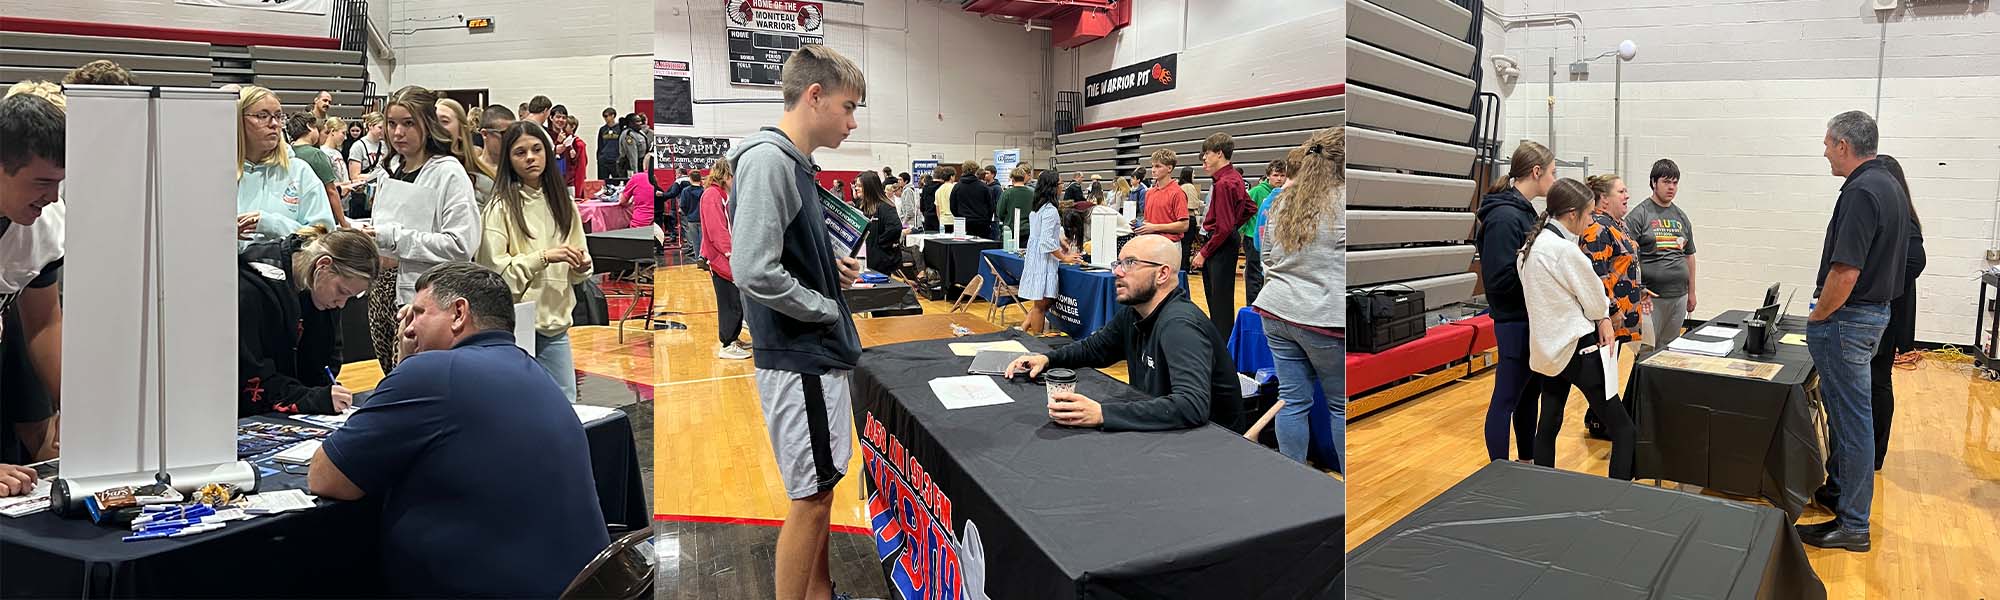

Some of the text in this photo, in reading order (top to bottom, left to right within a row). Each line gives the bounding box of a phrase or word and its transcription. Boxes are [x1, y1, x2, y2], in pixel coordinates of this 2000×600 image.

[753, 0, 797, 11] HOME OF THE
[755, 11, 795, 22] MONITEAU
[756, 21, 796, 31] WARRIORS
[800, 36, 822, 44] VISITOR
[1086, 69, 1151, 98] THE WARRIOR PIT
[688, 144, 721, 154] ARMY
[834, 208, 862, 230] FOUNDATION
[1651, 218, 1682, 230] PLUTO
[1056, 302, 1079, 316] COLLEGE
[888, 434, 904, 476] AM
[910, 456, 932, 508] 97.3
[932, 482, 952, 536] FM
[101, 490, 129, 501] Bars
